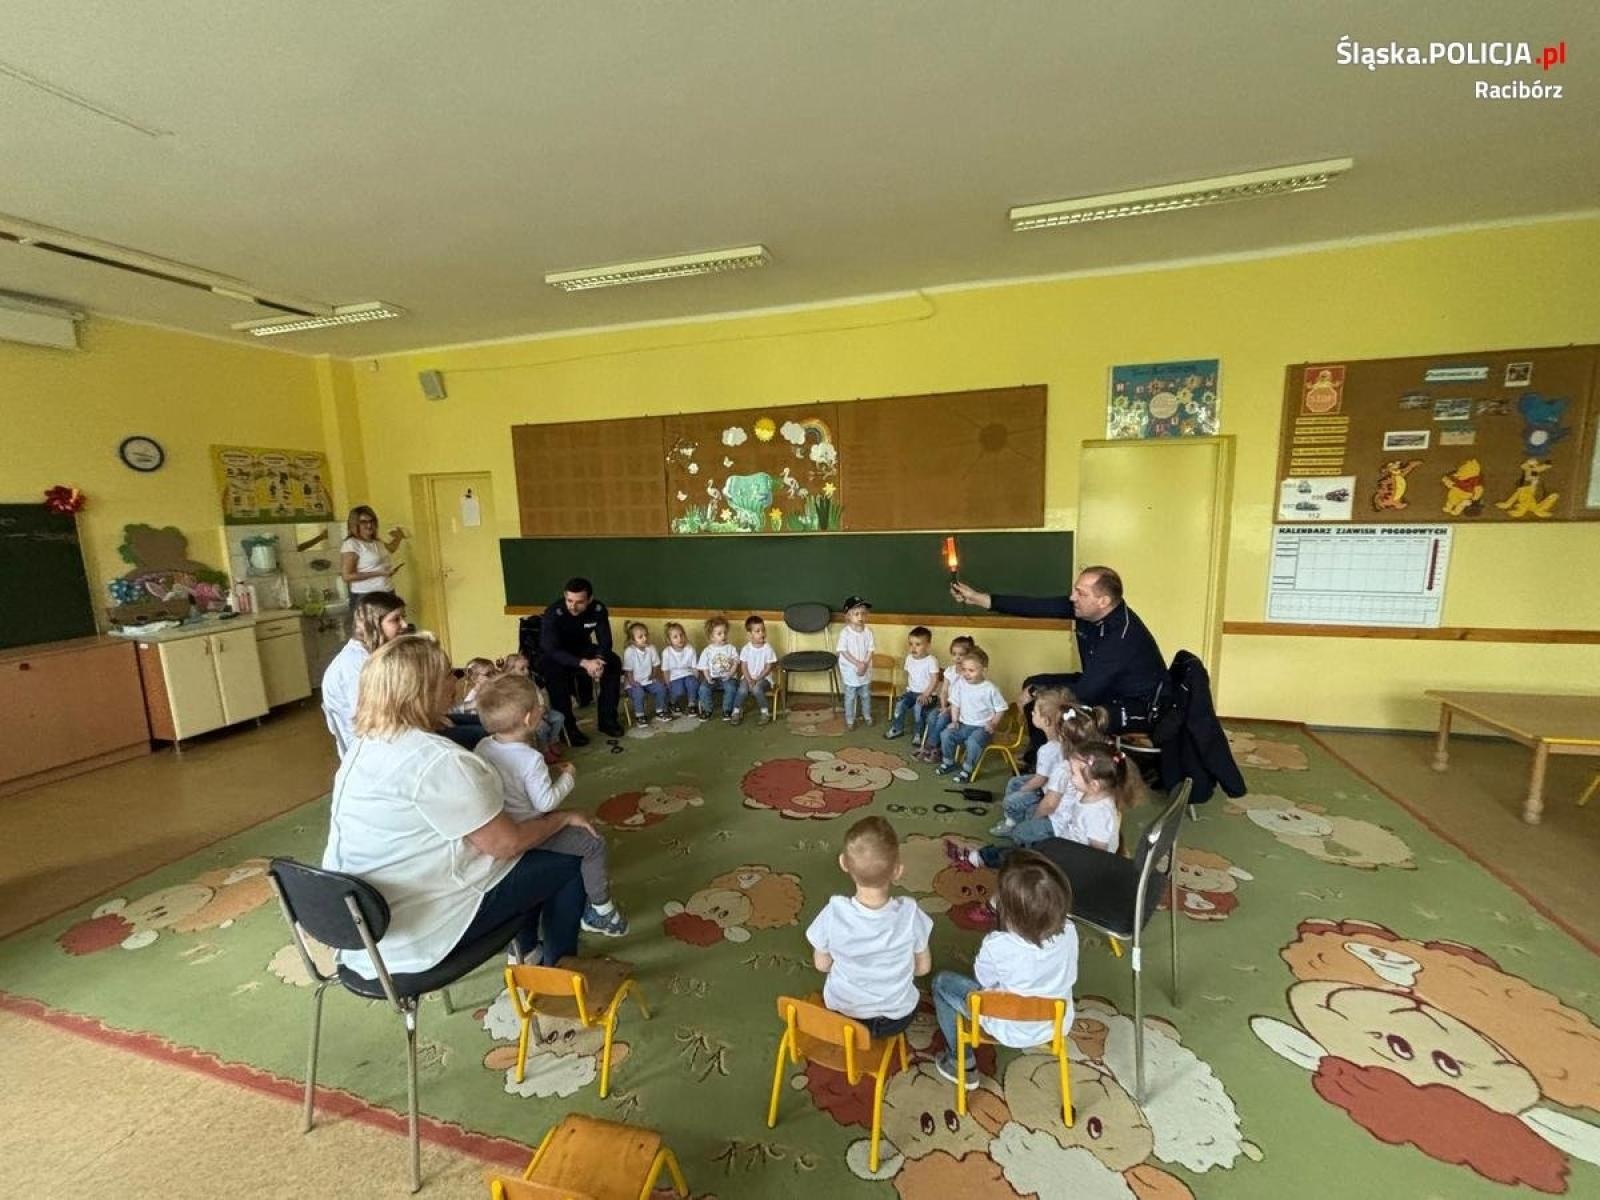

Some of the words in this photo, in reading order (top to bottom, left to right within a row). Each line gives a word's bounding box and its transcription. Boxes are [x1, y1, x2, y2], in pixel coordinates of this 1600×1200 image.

[1279, 527, 1332, 535] KALENDARZ
[1335, 527, 1377, 535] ZJAWISK
[1380, 527, 1448, 535] POGODOWYCH
